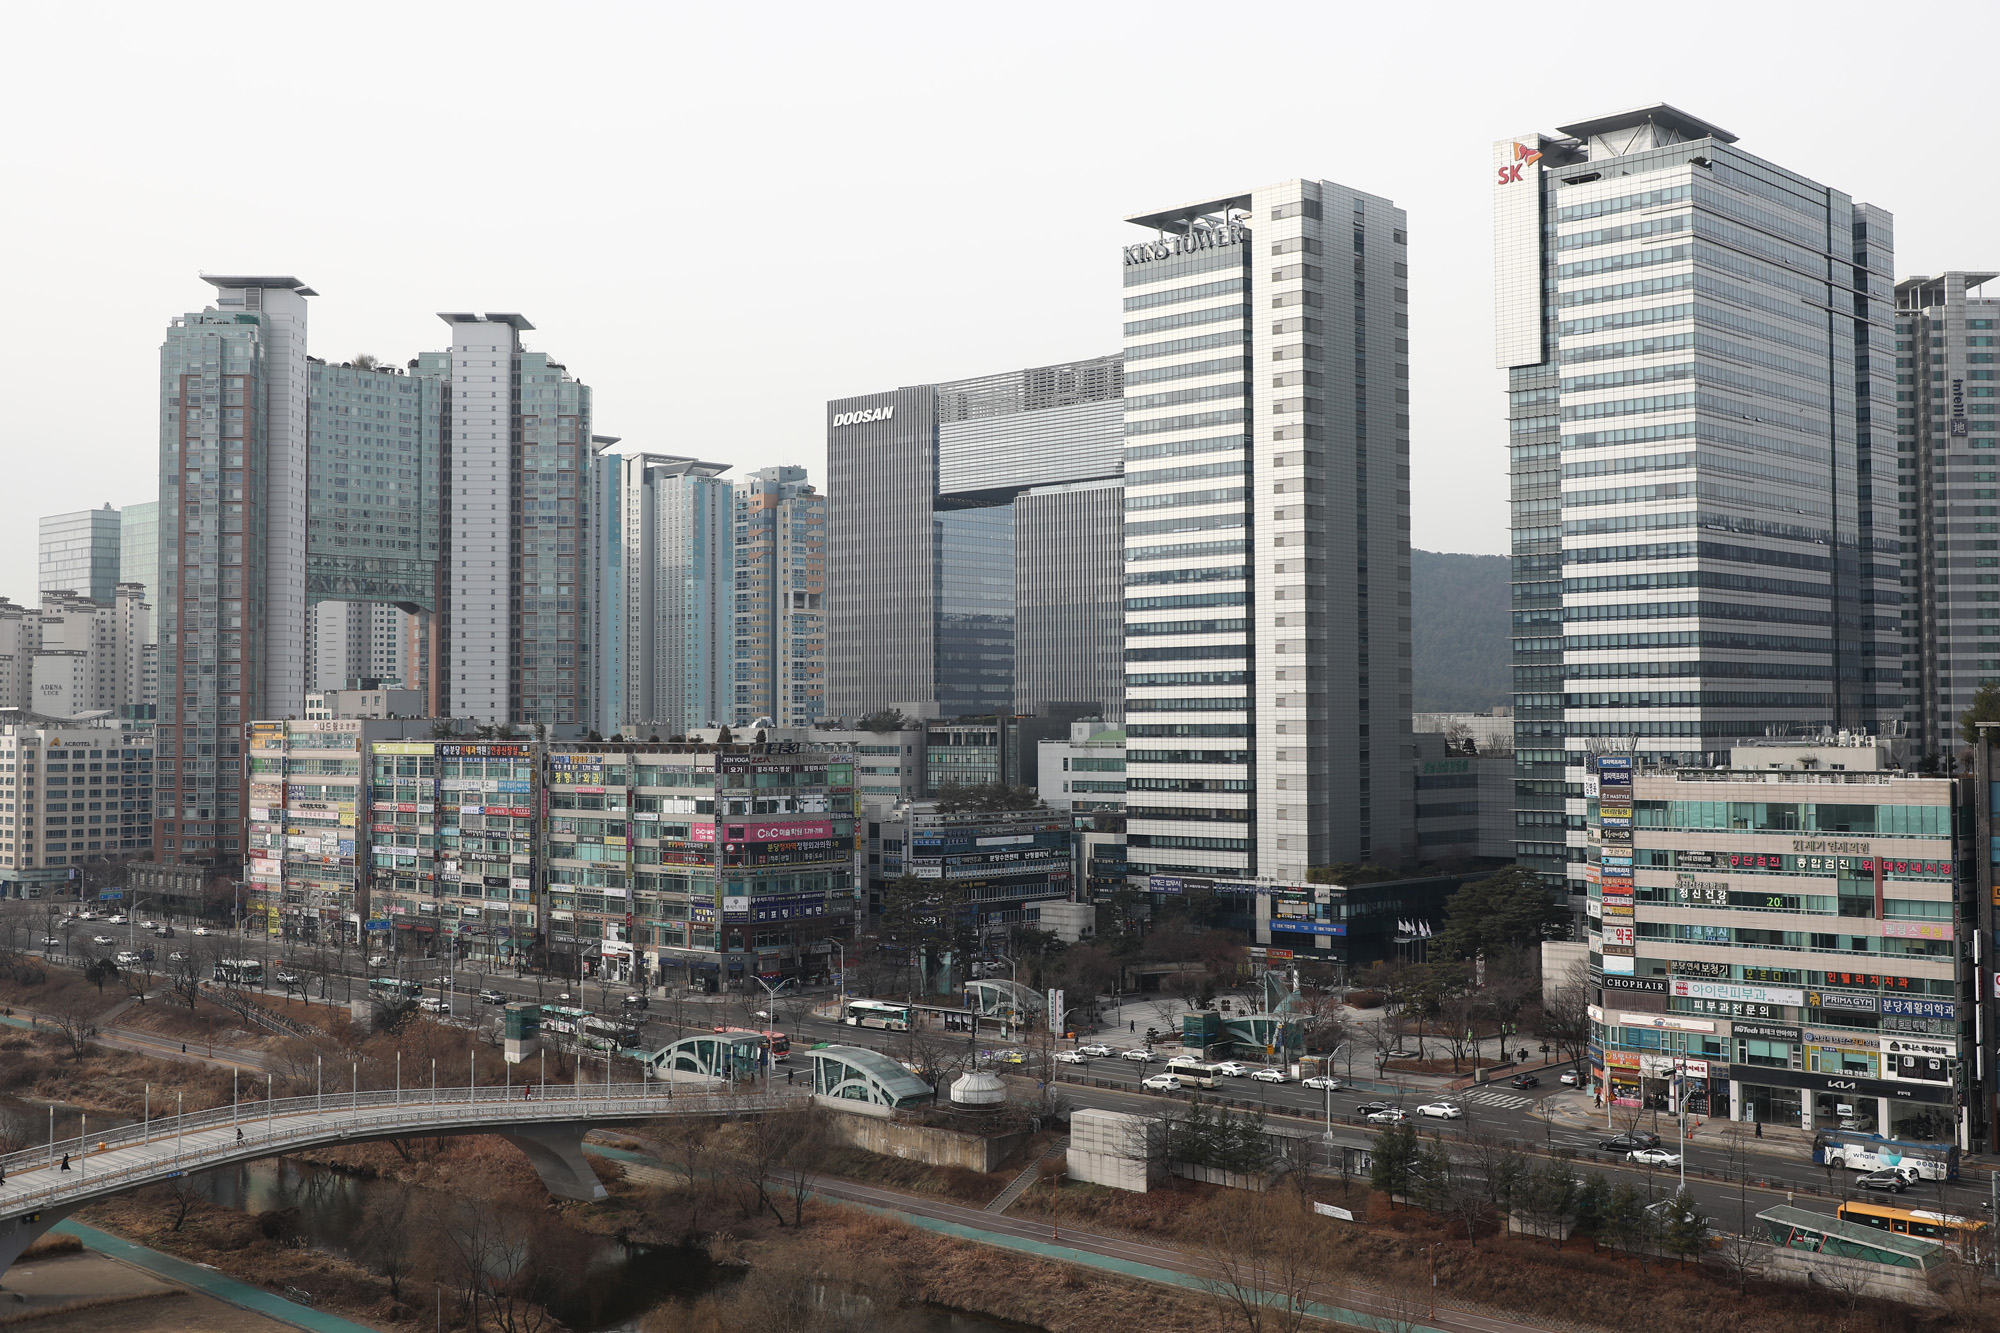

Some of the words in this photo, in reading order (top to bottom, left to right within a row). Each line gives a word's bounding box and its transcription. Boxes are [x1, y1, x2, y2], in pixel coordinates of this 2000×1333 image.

[1498, 164, 1523, 184] SK
[1122, 238, 1170, 266] KINS
[1170, 222, 1242, 256] TOWER
[1953, 379, 1964, 416] intelli
[834, 406, 894, 427] DOOSAN
[1954, 422, 1966, 433] 地
[758, 828, 778, 838] C&C
[1730, 855, 1780, 867] 공단검진
[1797, 858, 1850, 870] 종합검진
[1680, 889, 1726, 900] 정신건강
[759, 909, 788, 919] 리프팅
[1616, 928, 1632, 944] 약국
[1693, 926, 1727, 936] 세무사
[1701, 963, 1728, 975] 보청기
[1747, 969, 1782, 981] 오르다
[1607, 979, 1664, 990] CHOPHAIR
[1828, 972, 1908, 988] 인텔리지치과
[1693, 984, 1767, 1001] 아이린피부과
[1825, 995, 1852, 1004] PRIMA
[1854, 998, 1873, 1006] GYM
[1694, 1001, 1769, 1016] 피부과전문의
[1882, 1000, 1955, 1017] 분당재활의학과
[1853, 1152, 1875, 1161] whale
